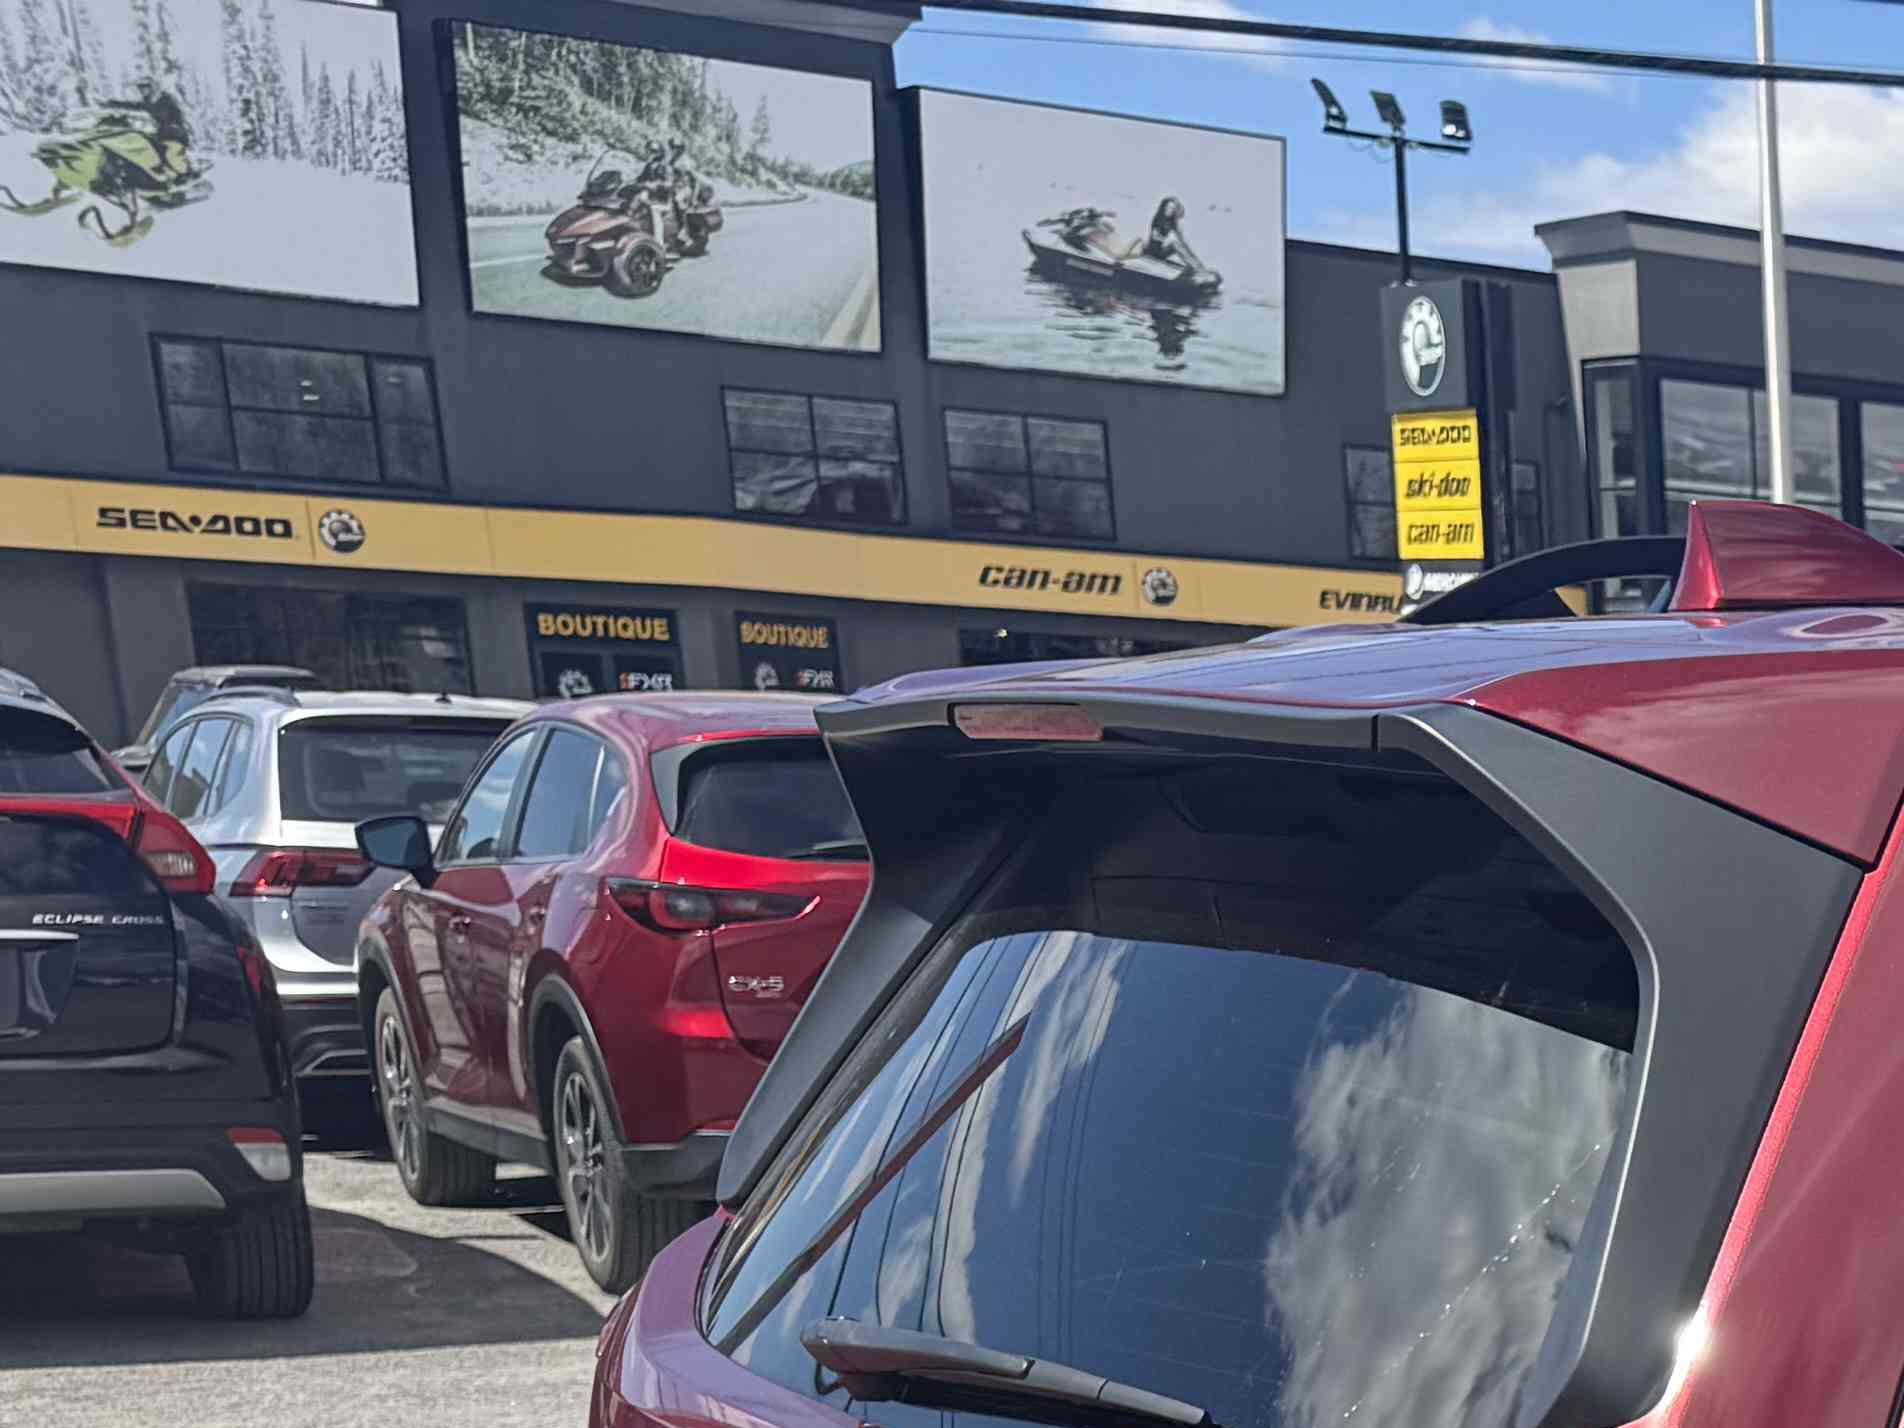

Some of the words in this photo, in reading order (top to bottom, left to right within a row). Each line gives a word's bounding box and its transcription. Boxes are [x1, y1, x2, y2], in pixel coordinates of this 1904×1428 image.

[1407, 521, 1475, 545] can-am
[978, 563, 1122, 596] can-am
[536, 612, 670, 641] BOUTIQUE
[739, 621, 829, 649] BOUTIQUE
[32, 913, 105, 925] ECLIPSE
[111, 914, 165, 926] CROSS
